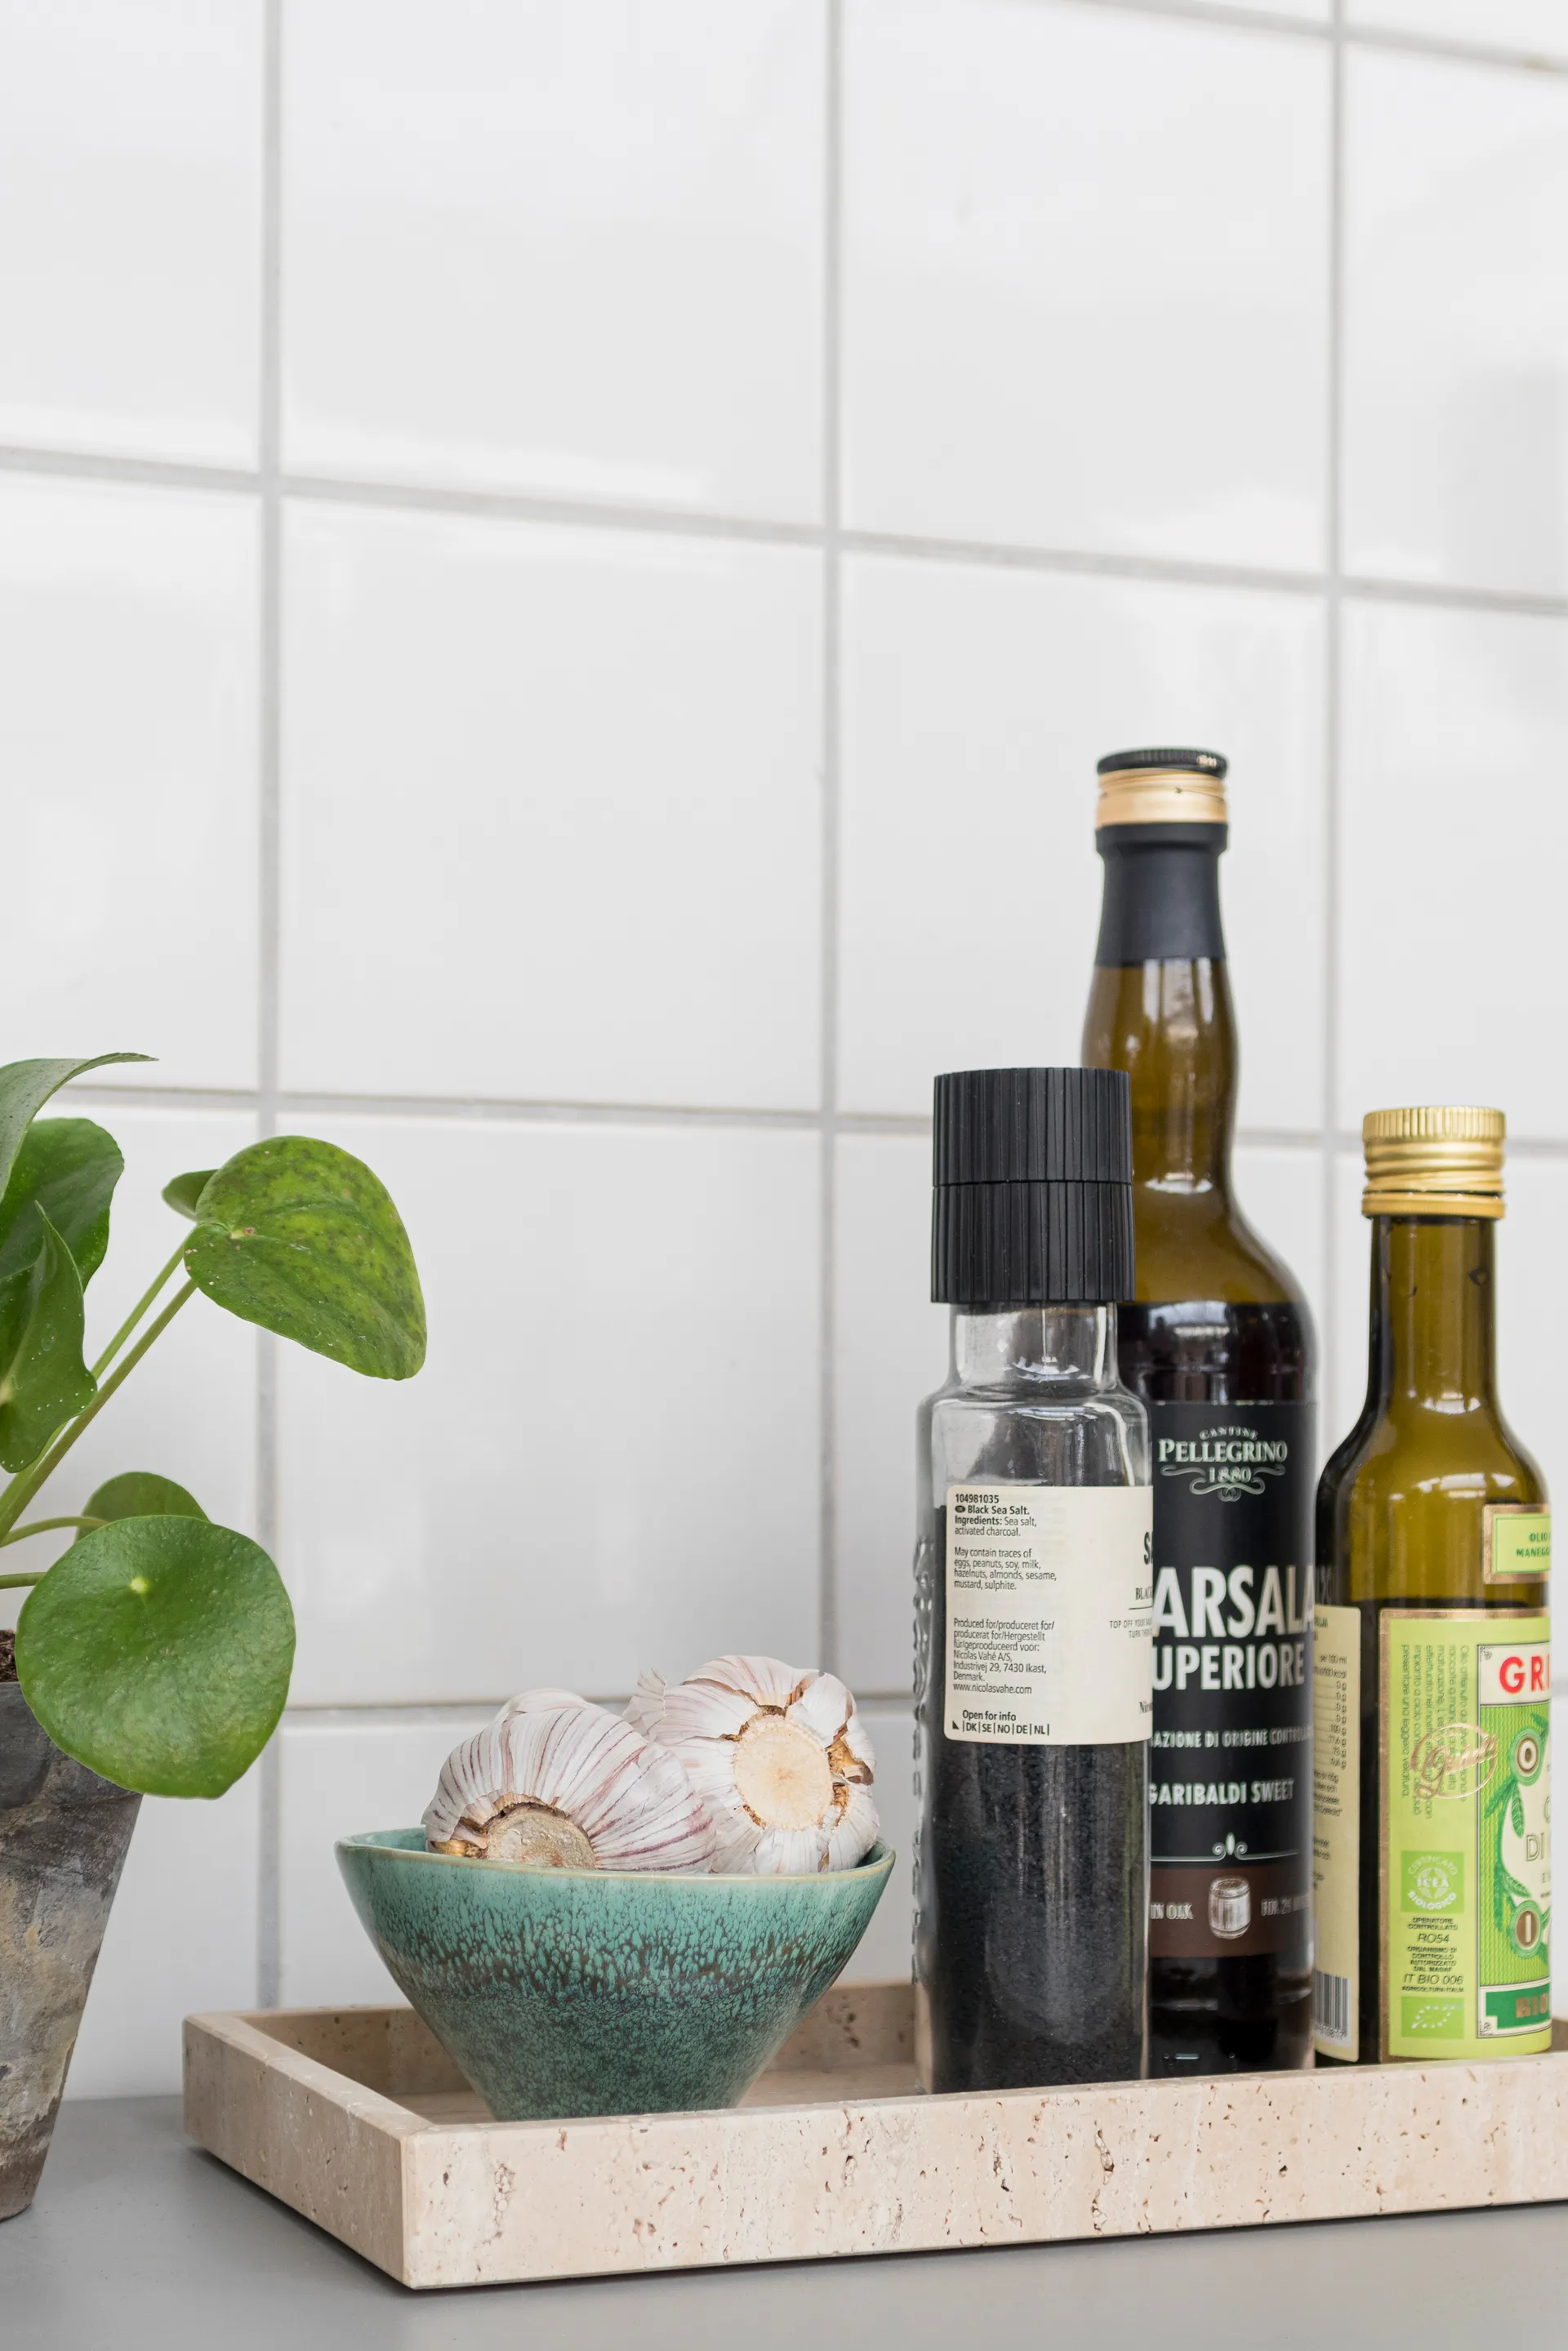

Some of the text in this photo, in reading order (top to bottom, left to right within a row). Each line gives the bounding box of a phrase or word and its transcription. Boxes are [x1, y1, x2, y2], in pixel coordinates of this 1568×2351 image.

[1199, 1426, 1258, 1440] CANTINE
[1157, 1438, 1288, 1463] PELLEGRINO
[1209, 1466, 1252, 1483] 1880
[955, 1494, 1000, 1504] 104981035
[968, 1505, 989, 1515] Black
[991, 1506, 1007, 1515] Sea
[1009, 1506, 1030, 1515] Salt.
[955, 1516, 1037, 1527] Ingredients: Sea salt,
[955, 1527, 1021, 1537] activated charcoal.
[954, 1547, 1032, 1558] May contain traces of
[954, 1559, 1041, 1570] eggs, peanuts, soy, milk,
[954, 1569, 1057, 1581] hazelnuts, almonds, sesame,
[954, 1580, 1017, 1592] mustard, sulphite.
[954, 1618, 1055, 1632] Produced for/produceret for/
[1109, 1620, 1122, 1629] TOP
[954, 1630, 1045, 1642] producerat for/Hergestellt
[1019, 1643, 1040, 1652] voor:
[954, 1650, 1013, 1663] Nicolas Vahé A/S,
[954, 1661, 1047, 1674] Industrivej 29, 7430 Ikast,
[953, 1672, 985, 1681] Denmark.
[953, 1683, 1032, 1694] www.nicolasvahe.com
[962, 1710, 1017, 1721] Open for info
[1151, 1730, 1201, 1748] AZIONE
[1205, 1730, 1219, 1748] DI
[1222, 1728, 1268, 1748] ORIGINE
[1148, 1782, 1247, 1806] GARIBALDI
[1251, 1778, 1294, 1802] SWEET
[1525, 1832, 1545, 1862] DI
[1417, 1878, 1449, 1888] ICEA
[1407, 1890, 1457, 1910] BIOLOGICO
[1166, 1903, 1194, 1919] OAK
[1404, 1974, 1464, 1985] IT BIO 006
